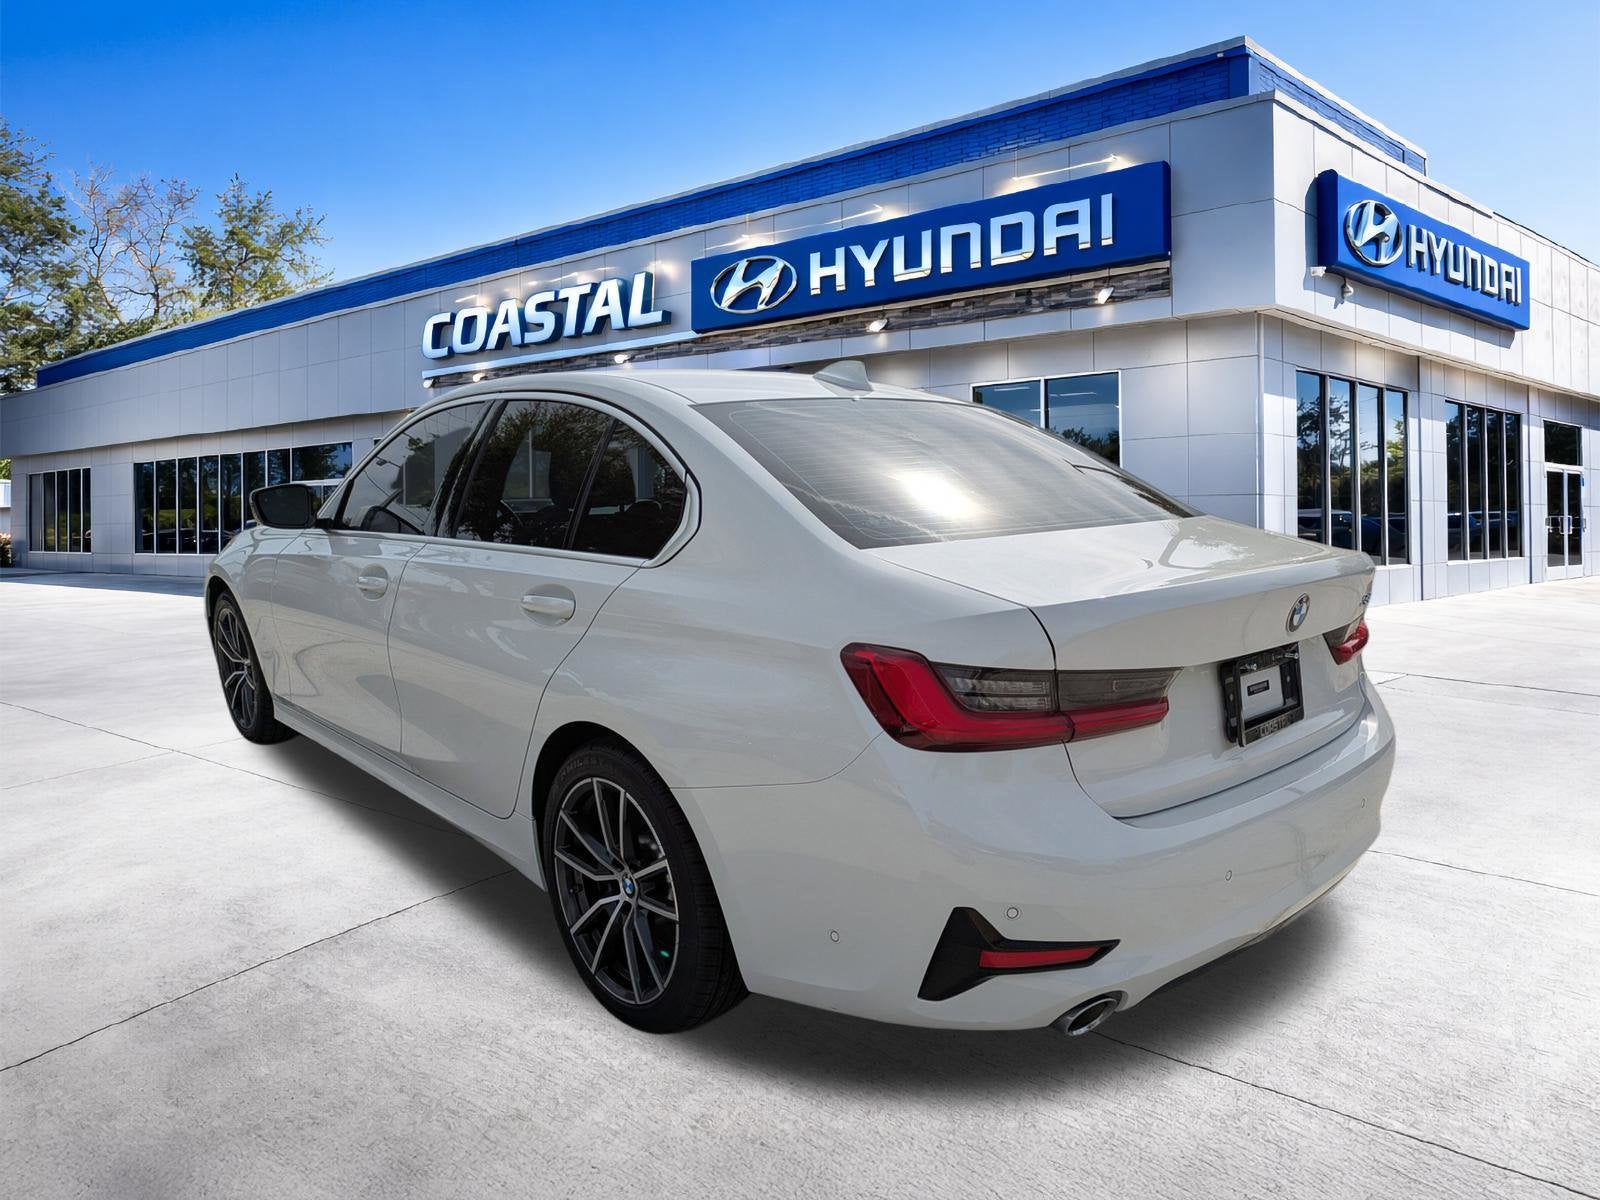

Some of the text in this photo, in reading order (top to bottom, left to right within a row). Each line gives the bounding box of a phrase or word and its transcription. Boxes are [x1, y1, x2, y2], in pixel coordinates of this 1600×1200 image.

[809, 193, 1113, 296] HYUNDAI
[1406, 224, 1522, 305] HYUNDAI
[422, 271, 670, 359] COASTAL
